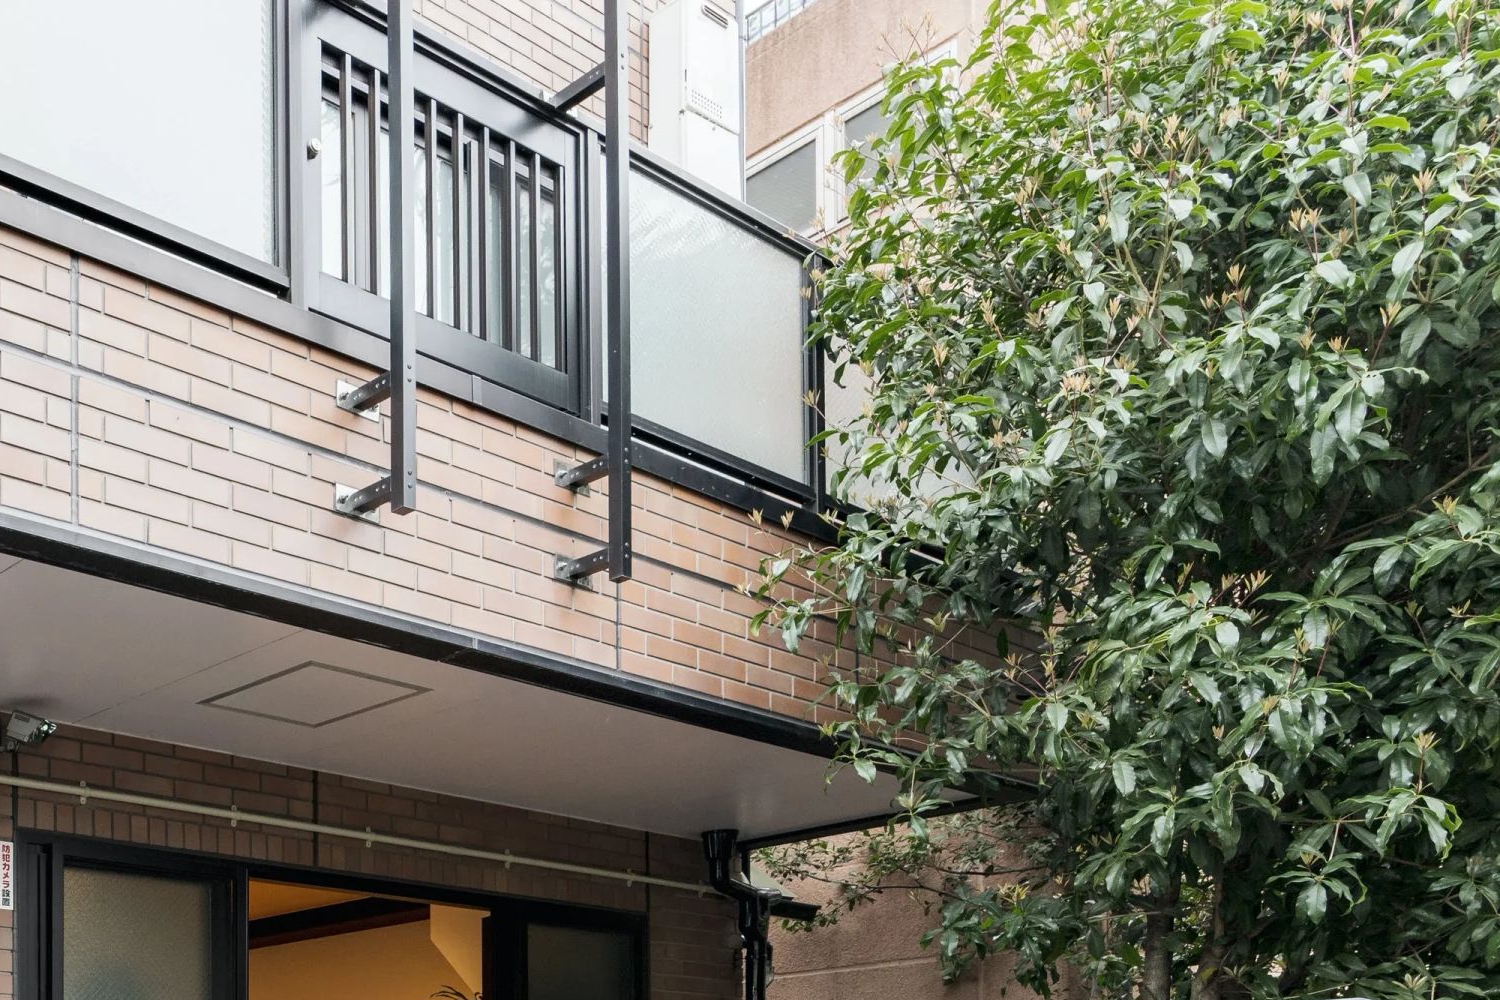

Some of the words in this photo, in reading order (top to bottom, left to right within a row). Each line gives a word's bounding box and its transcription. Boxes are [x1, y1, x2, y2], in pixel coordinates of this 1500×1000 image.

[2, 845, 10, 906] 防犯カメラ設置
